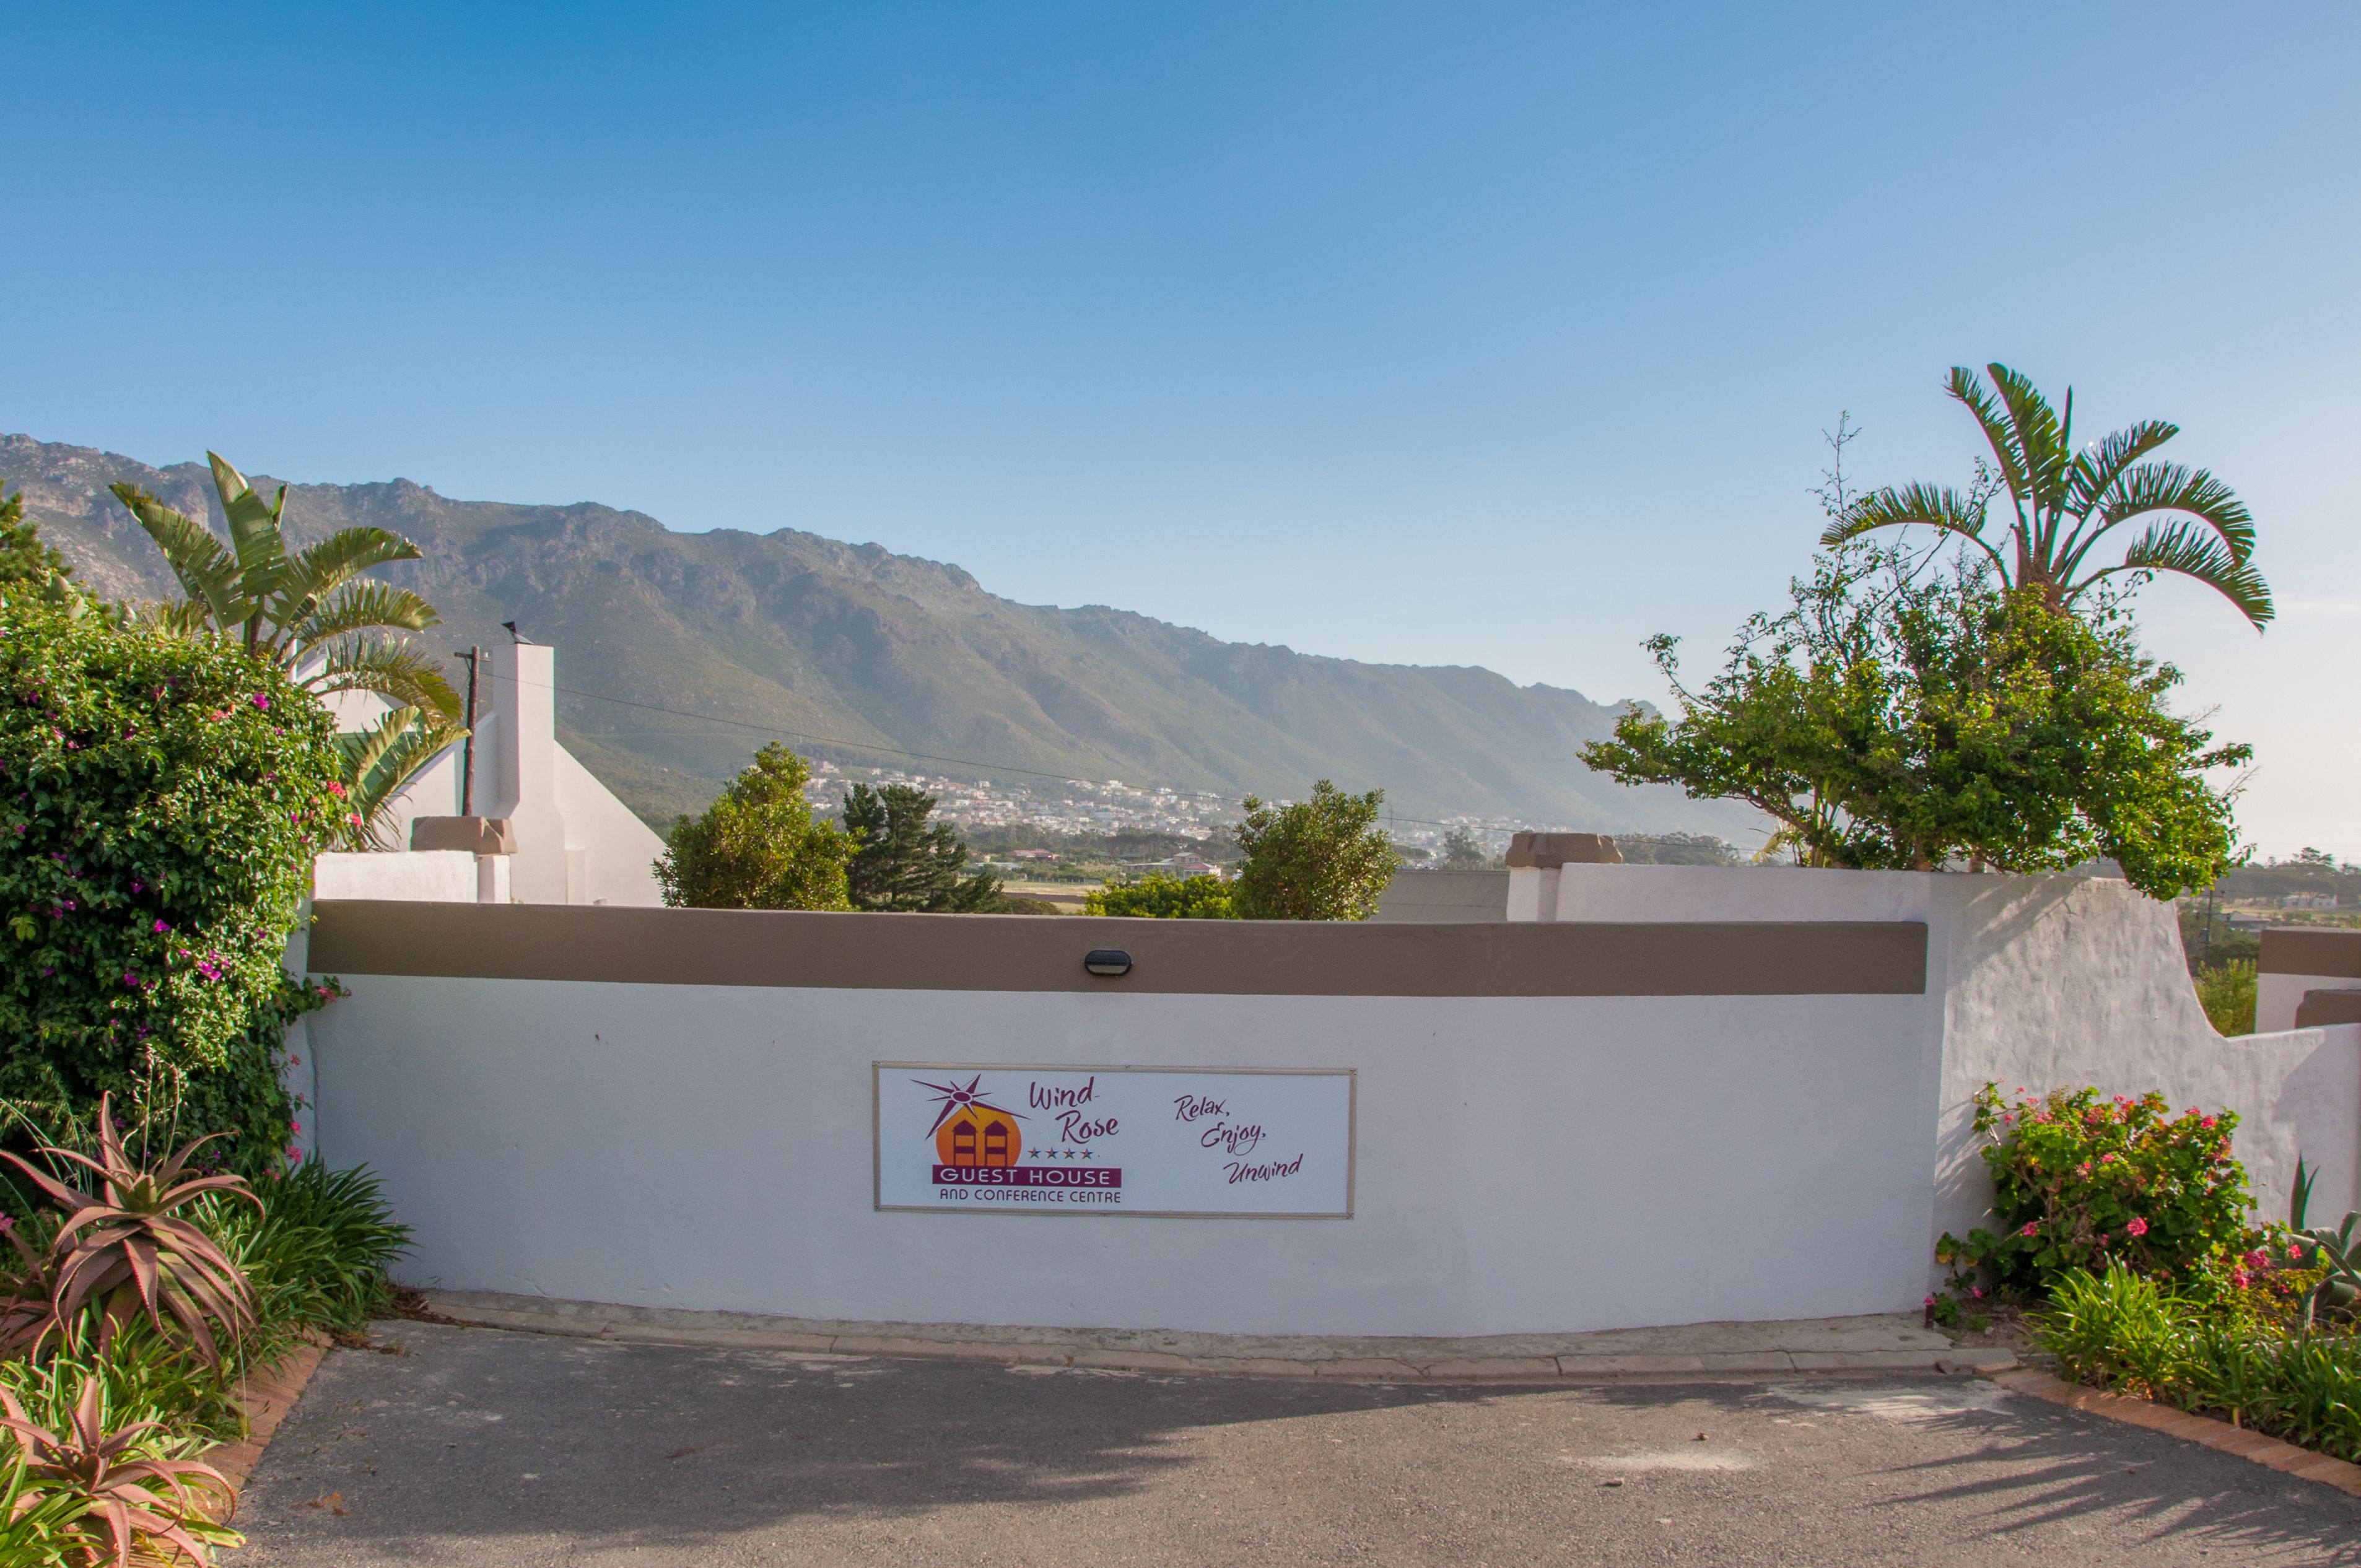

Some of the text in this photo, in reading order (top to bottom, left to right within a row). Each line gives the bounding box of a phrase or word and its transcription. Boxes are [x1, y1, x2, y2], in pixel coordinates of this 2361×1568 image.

[1174, 1094, 1230, 1122] Relax,
[1055, 1110, 1120, 1144] Rose
[940, 1168, 1110, 1185] GUEST HOUSE
[1223, 1153, 1304, 1184] Unwind
[940, 1188, 1120, 1203] AND CONFERENCE CENTRE
